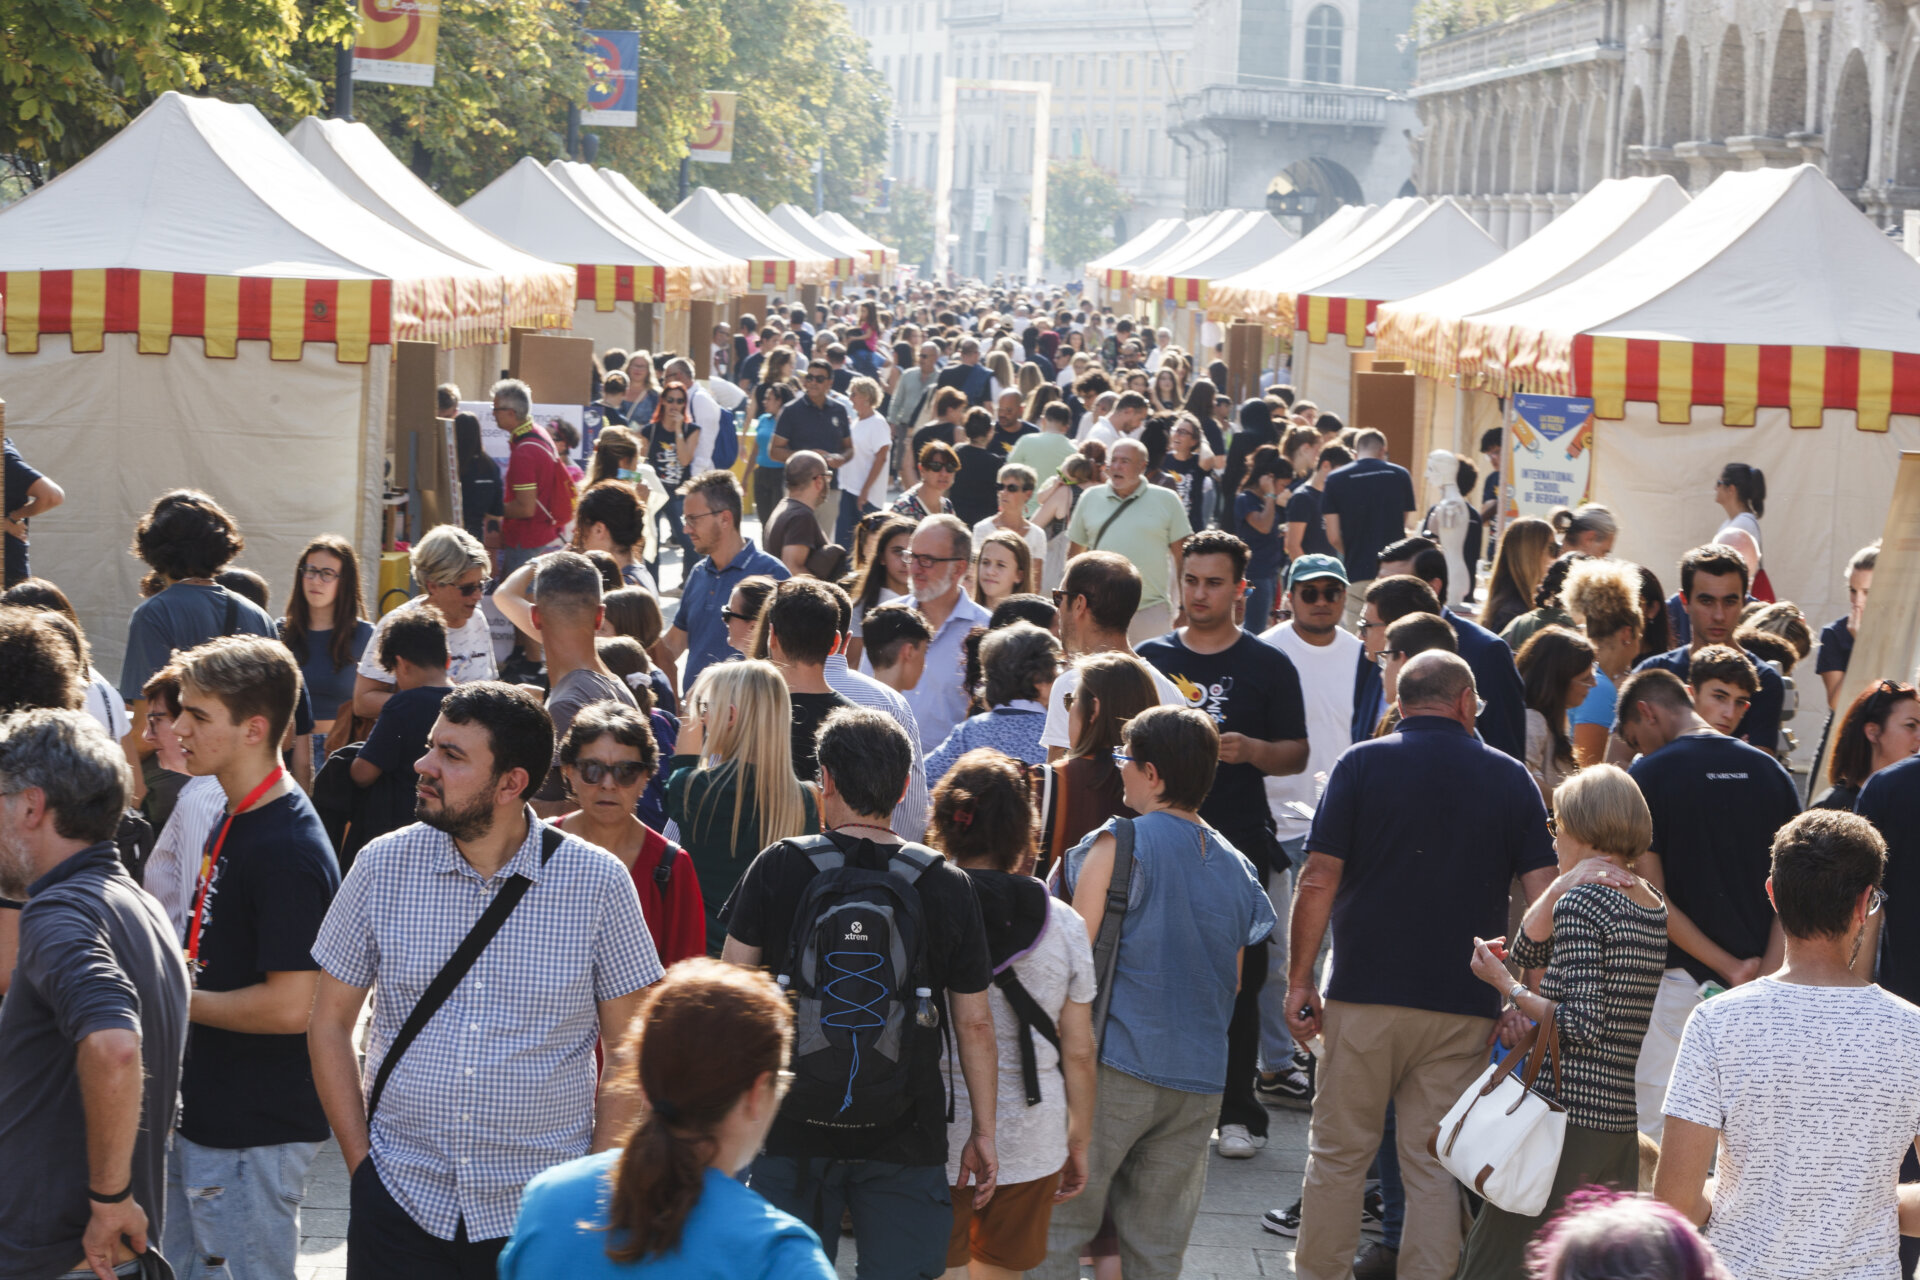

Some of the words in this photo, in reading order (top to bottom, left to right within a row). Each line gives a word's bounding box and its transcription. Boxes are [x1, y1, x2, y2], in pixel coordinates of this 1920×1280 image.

[1521, 468, 1575, 483] INTERNATIONAL
[1533, 481, 1560, 493] SCHOOL
[1524, 492, 1534, 503] OF
[1535, 493, 1569, 506] BERGAMO
[844, 932, 869, 941] xtrem
